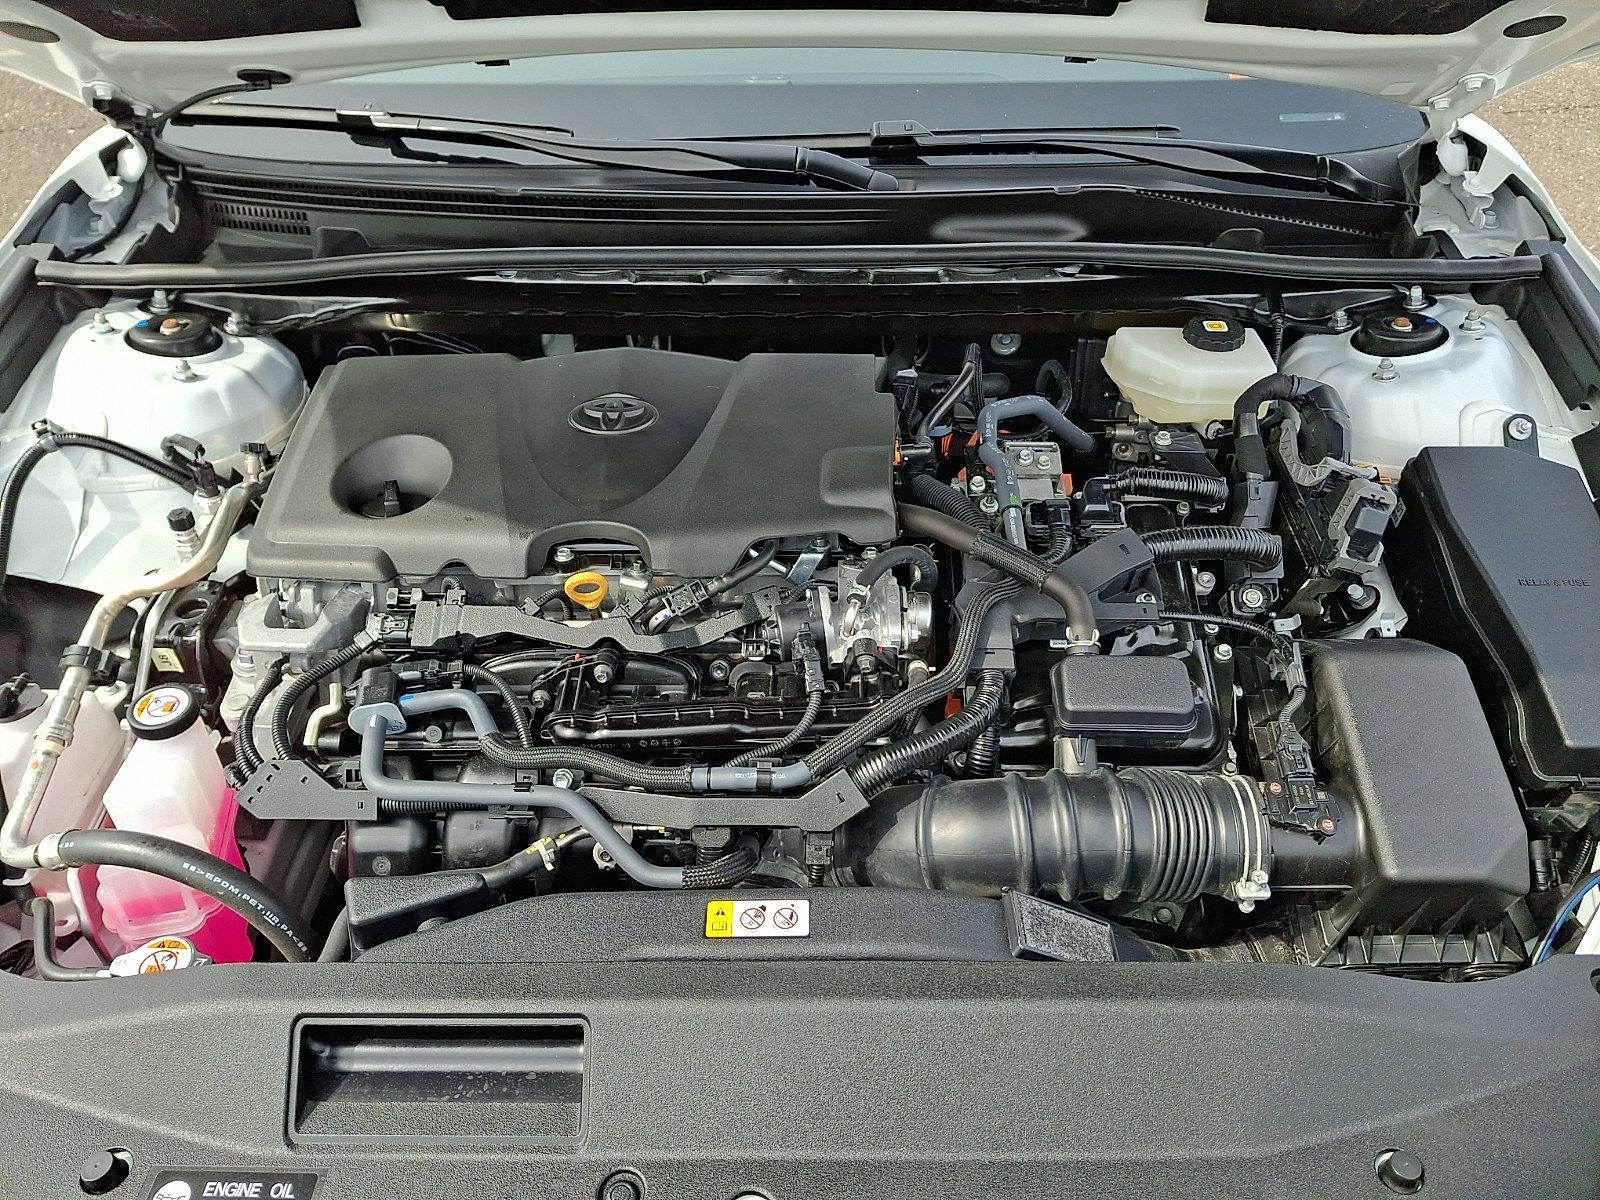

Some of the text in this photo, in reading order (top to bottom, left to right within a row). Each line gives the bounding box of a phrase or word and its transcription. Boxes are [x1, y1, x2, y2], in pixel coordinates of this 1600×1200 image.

[1517, 578, 1550, 587] RELAY
[1562, 579, 1590, 587] FUSE
[202, 1181, 296, 1199] ENGINE OIL
